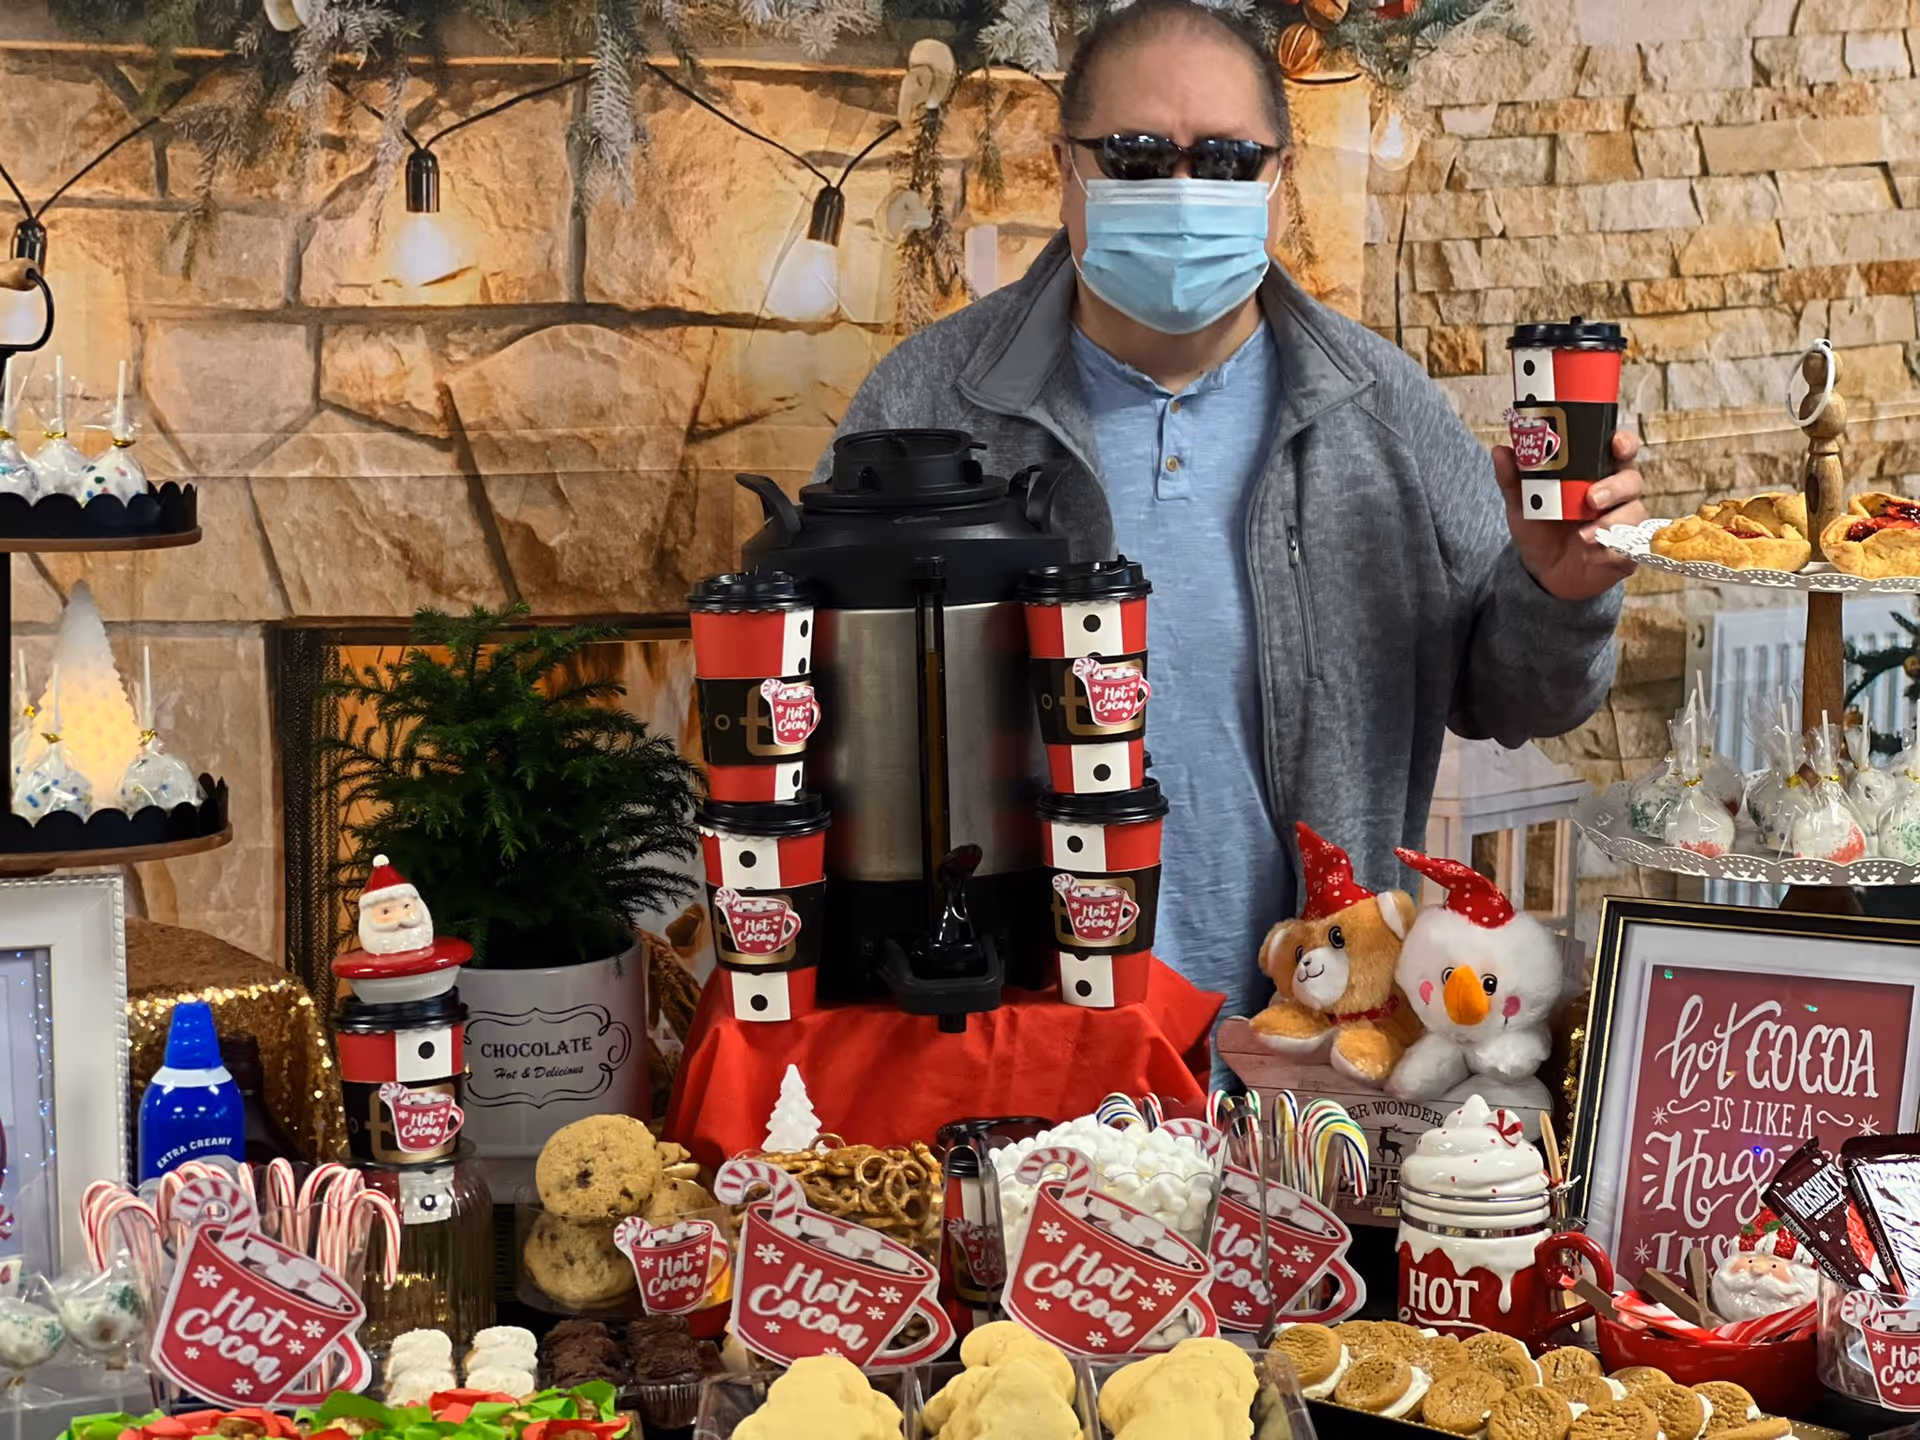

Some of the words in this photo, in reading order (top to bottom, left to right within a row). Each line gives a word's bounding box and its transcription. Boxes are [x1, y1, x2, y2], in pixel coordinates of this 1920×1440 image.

[1515, 445, 1541, 458] Cocoa
[1518, 433, 1537, 448] Hot
[1104, 685, 1130, 701] Hot
[786, 705, 806, 721] Hot
[1095, 699, 1133, 713] Cocoa
[778, 719, 808, 732] Cocoa
[1075, 916, 1115, 929] Cocoa
[1082, 904, 1111, 919] Hot
[737, 930, 778, 943] Cocoa
[745, 918, 773, 933] Hot
[480, 1036, 593, 1058] CHOCOLATE
[1654, 994, 1781, 1098] hot
[1745, 1020, 1880, 1098] COCOA
[494, 1066, 518, 1080] Hot
[521, 1066, 531, 1079] &
[534, 1064, 584, 1080] Delicious
[410, 1110, 439, 1127] Hot
[1372, 1101, 1446, 1128] WONDER
[1711, 1096, 1735, 1130] IS
[1740, 1099, 1796, 1137] LIKE
[1797, 1104, 1813, 1140] A
[401, 1124, 442, 1138] Cocoa
[156, 1145, 188, 1169] EXTRA
[189, 1137, 233, 1150] CREAMY
[1645, 1128, 1774, 1229] Hug
[1785, 1162, 1848, 1220] HERSHEY'S
[658, 1251, 696, 1278] Hot
[1809, 1246, 1826, 1264] MILK
[1059, 1242, 1149, 1301] Hot
[647, 1273, 702, 1297] Cocoa
[783, 1262, 874, 1314] Hot
[1408, 1267, 1480, 1319] HOT
[1023, 1261, 1135, 1338] Cocoa
[211, 1287, 298, 1346] Hot
[748, 1283, 869, 1351] Cocoa
[175, 1307, 282, 1384] Cocoa
